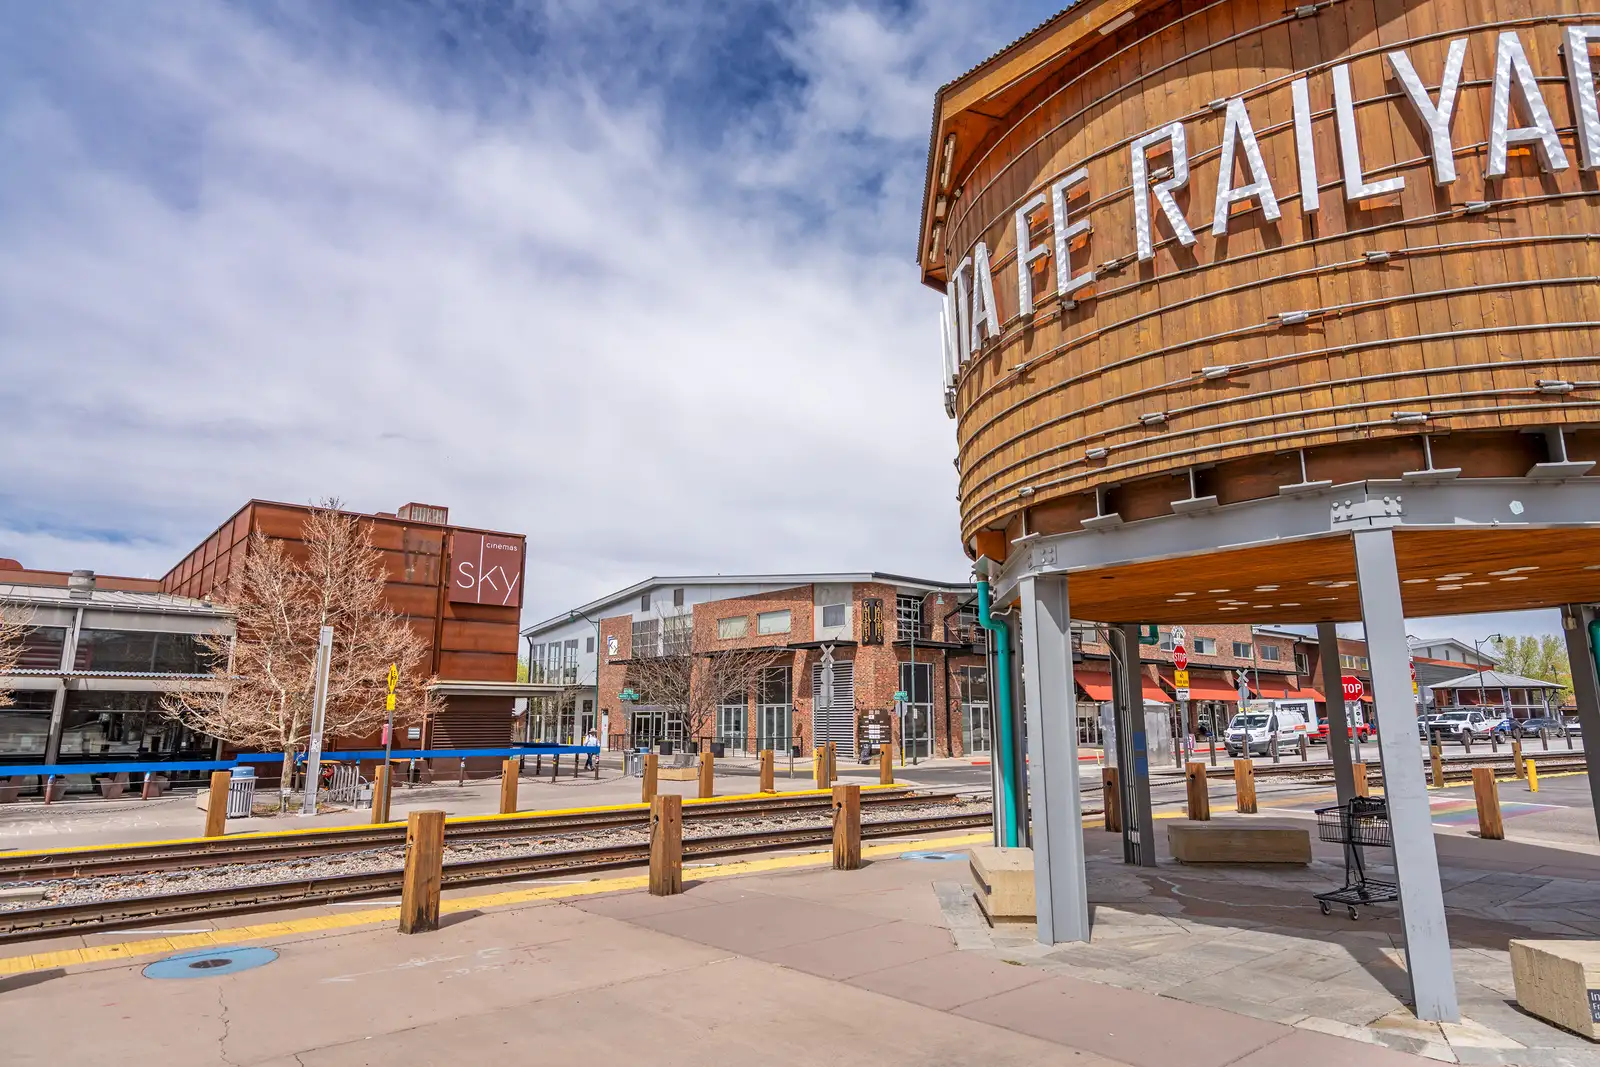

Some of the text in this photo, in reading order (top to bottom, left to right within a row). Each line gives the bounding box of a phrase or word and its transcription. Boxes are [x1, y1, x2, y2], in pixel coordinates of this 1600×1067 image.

[1015, 168, 1096, 317] FE
[1130, 26, 1600, 263] RAILYA
[486, 542, 518, 552] cinemas
[1174, 652, 1186, 663] STOP
[1342, 683, 1361, 694] TOP
